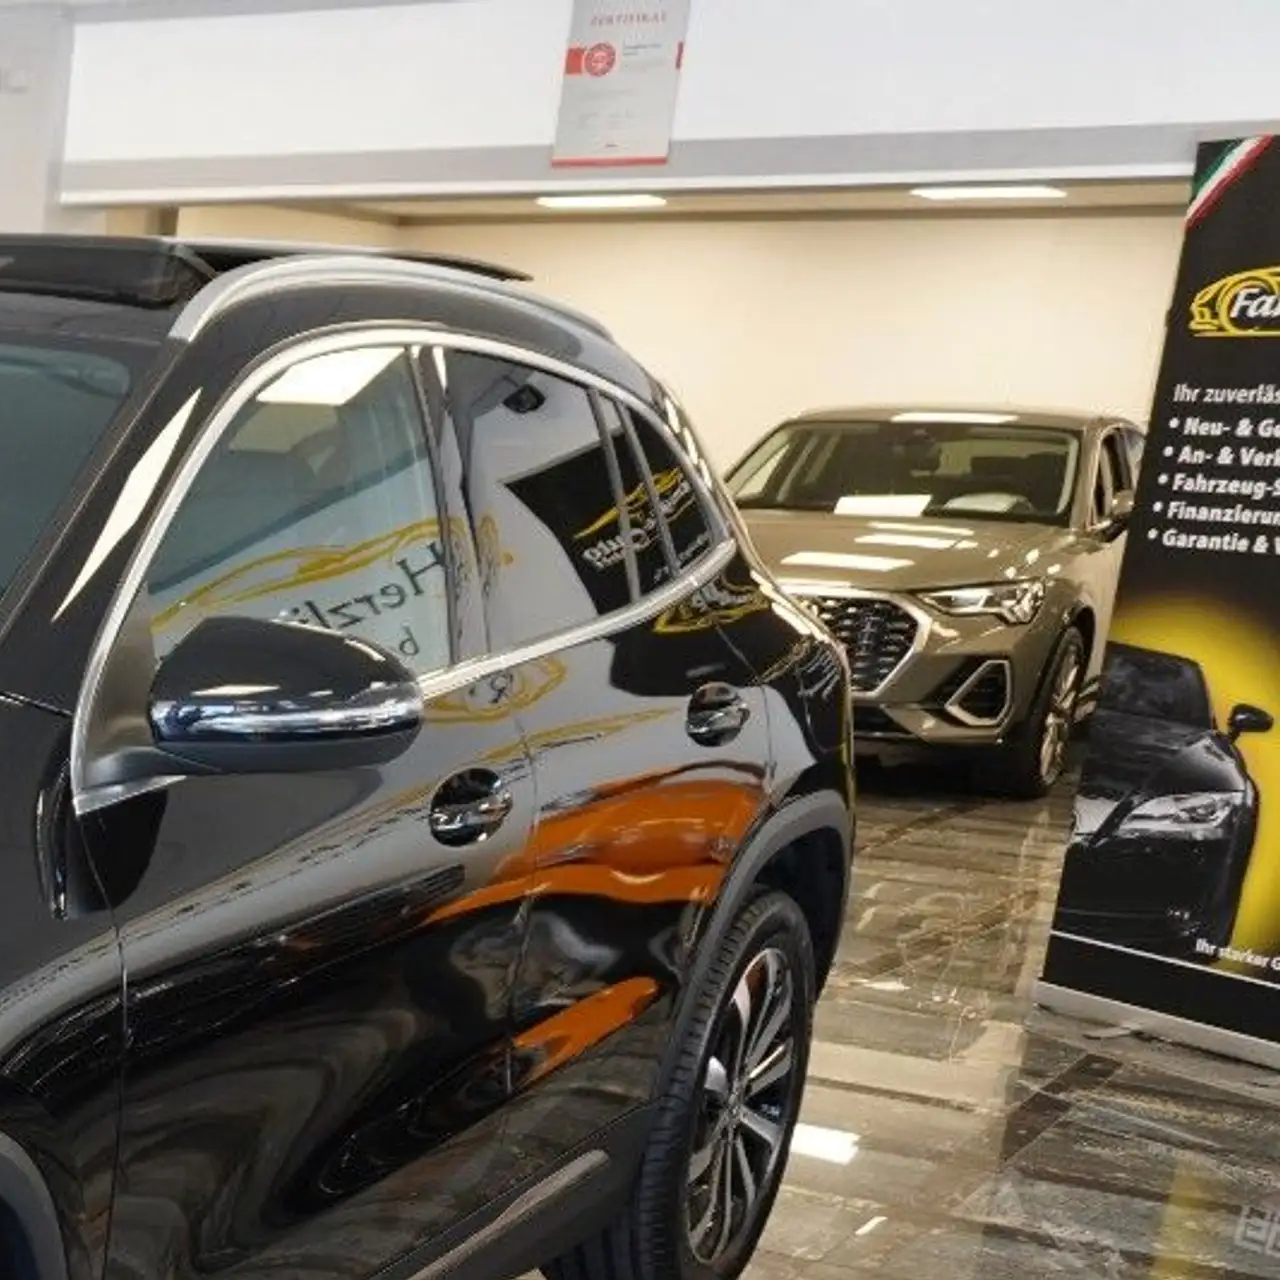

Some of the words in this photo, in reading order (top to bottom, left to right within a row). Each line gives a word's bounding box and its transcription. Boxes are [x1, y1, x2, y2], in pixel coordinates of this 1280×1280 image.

[1229, 287, 1280, 319] Fa
[1173, 383, 1200, 403] Ihr
[1184, 417, 1231, 437] Neu-
[1235, 418, 1254, 438] &
[1177, 445, 1213, 465] An-
[1217, 446, 1234, 465] &
[1162, 529, 1250, 553] Garantie
[1253, 534, 1269, 554] &
[1196, 937, 1217, 956] Ihr
